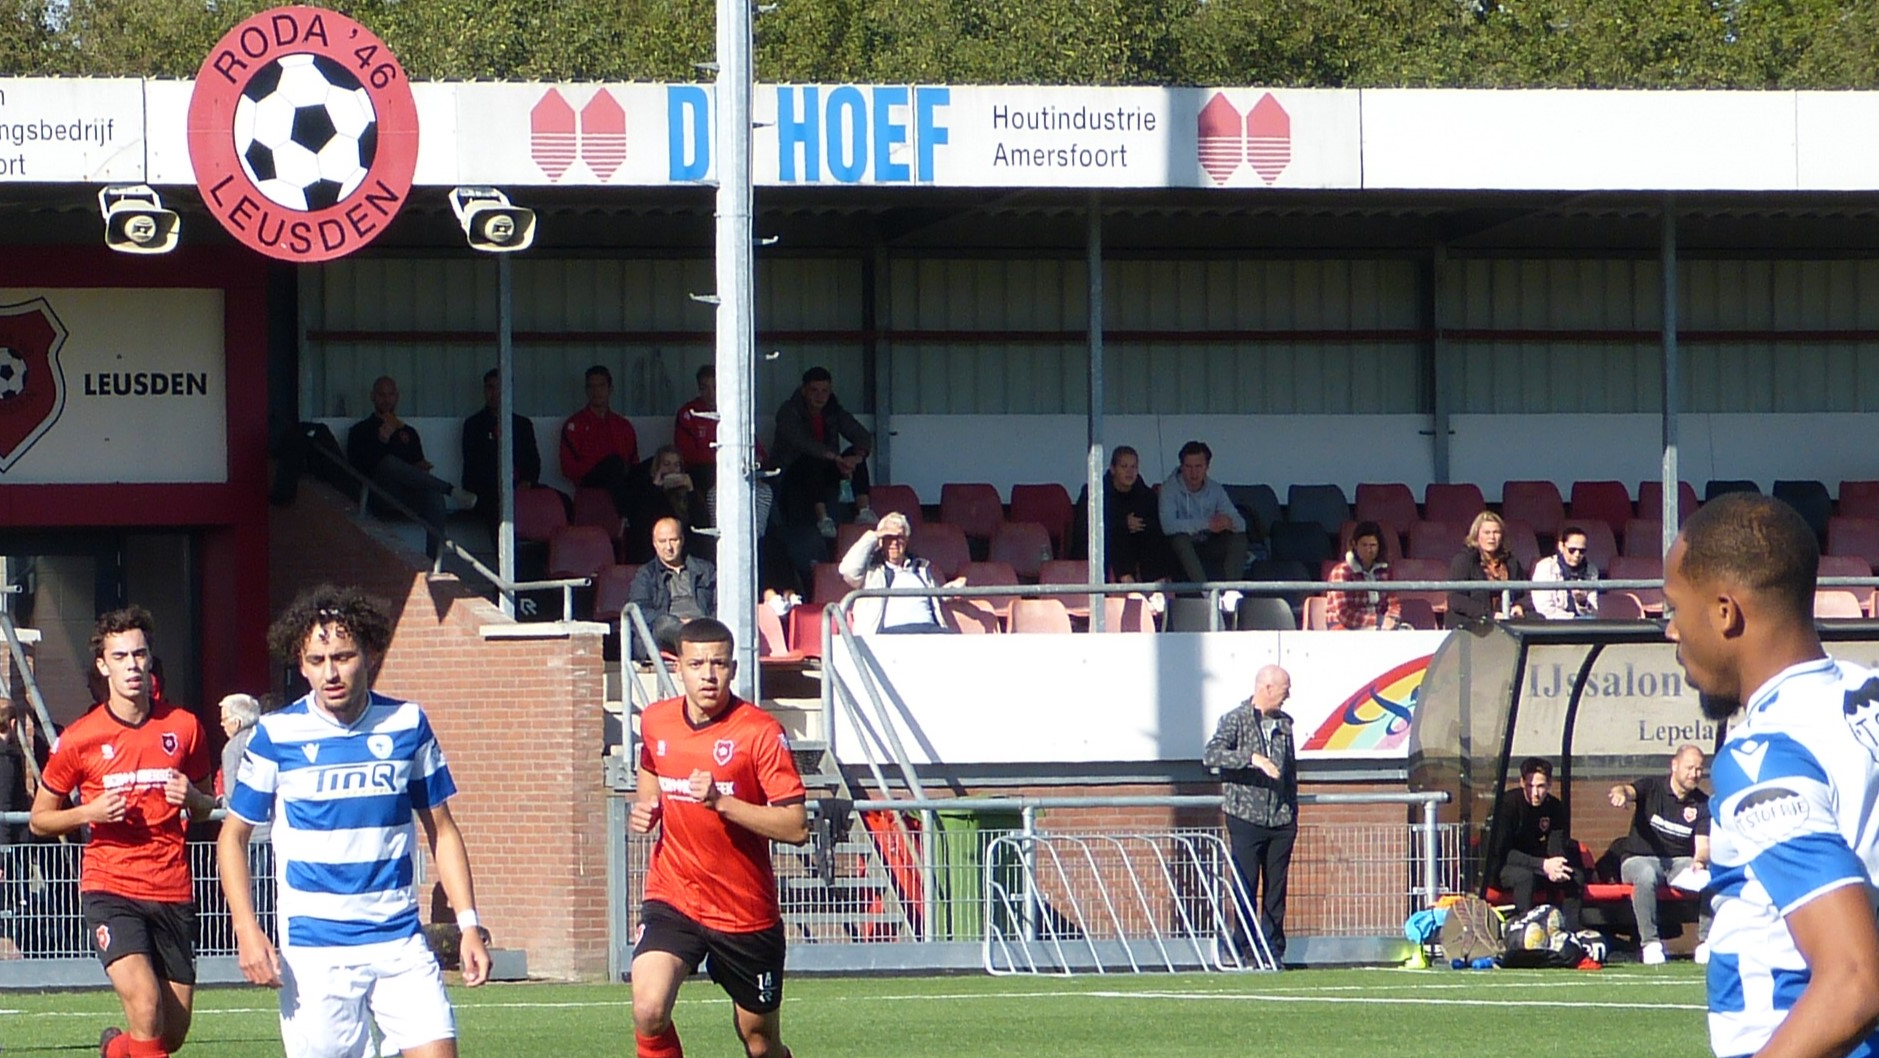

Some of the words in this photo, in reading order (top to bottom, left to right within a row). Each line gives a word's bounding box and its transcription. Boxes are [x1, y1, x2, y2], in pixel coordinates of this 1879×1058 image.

[213, 14, 329, 84] RODA
[349, 28, 397, 89] '46
[778, 87, 950, 183] HOEF
[993, 105, 1157, 131] Houtindustrie
[993, 142, 1128, 168] Amersfoort
[209, 174, 399, 254] LEUSDEN
[83, 373, 207, 397] LEUSDEN
